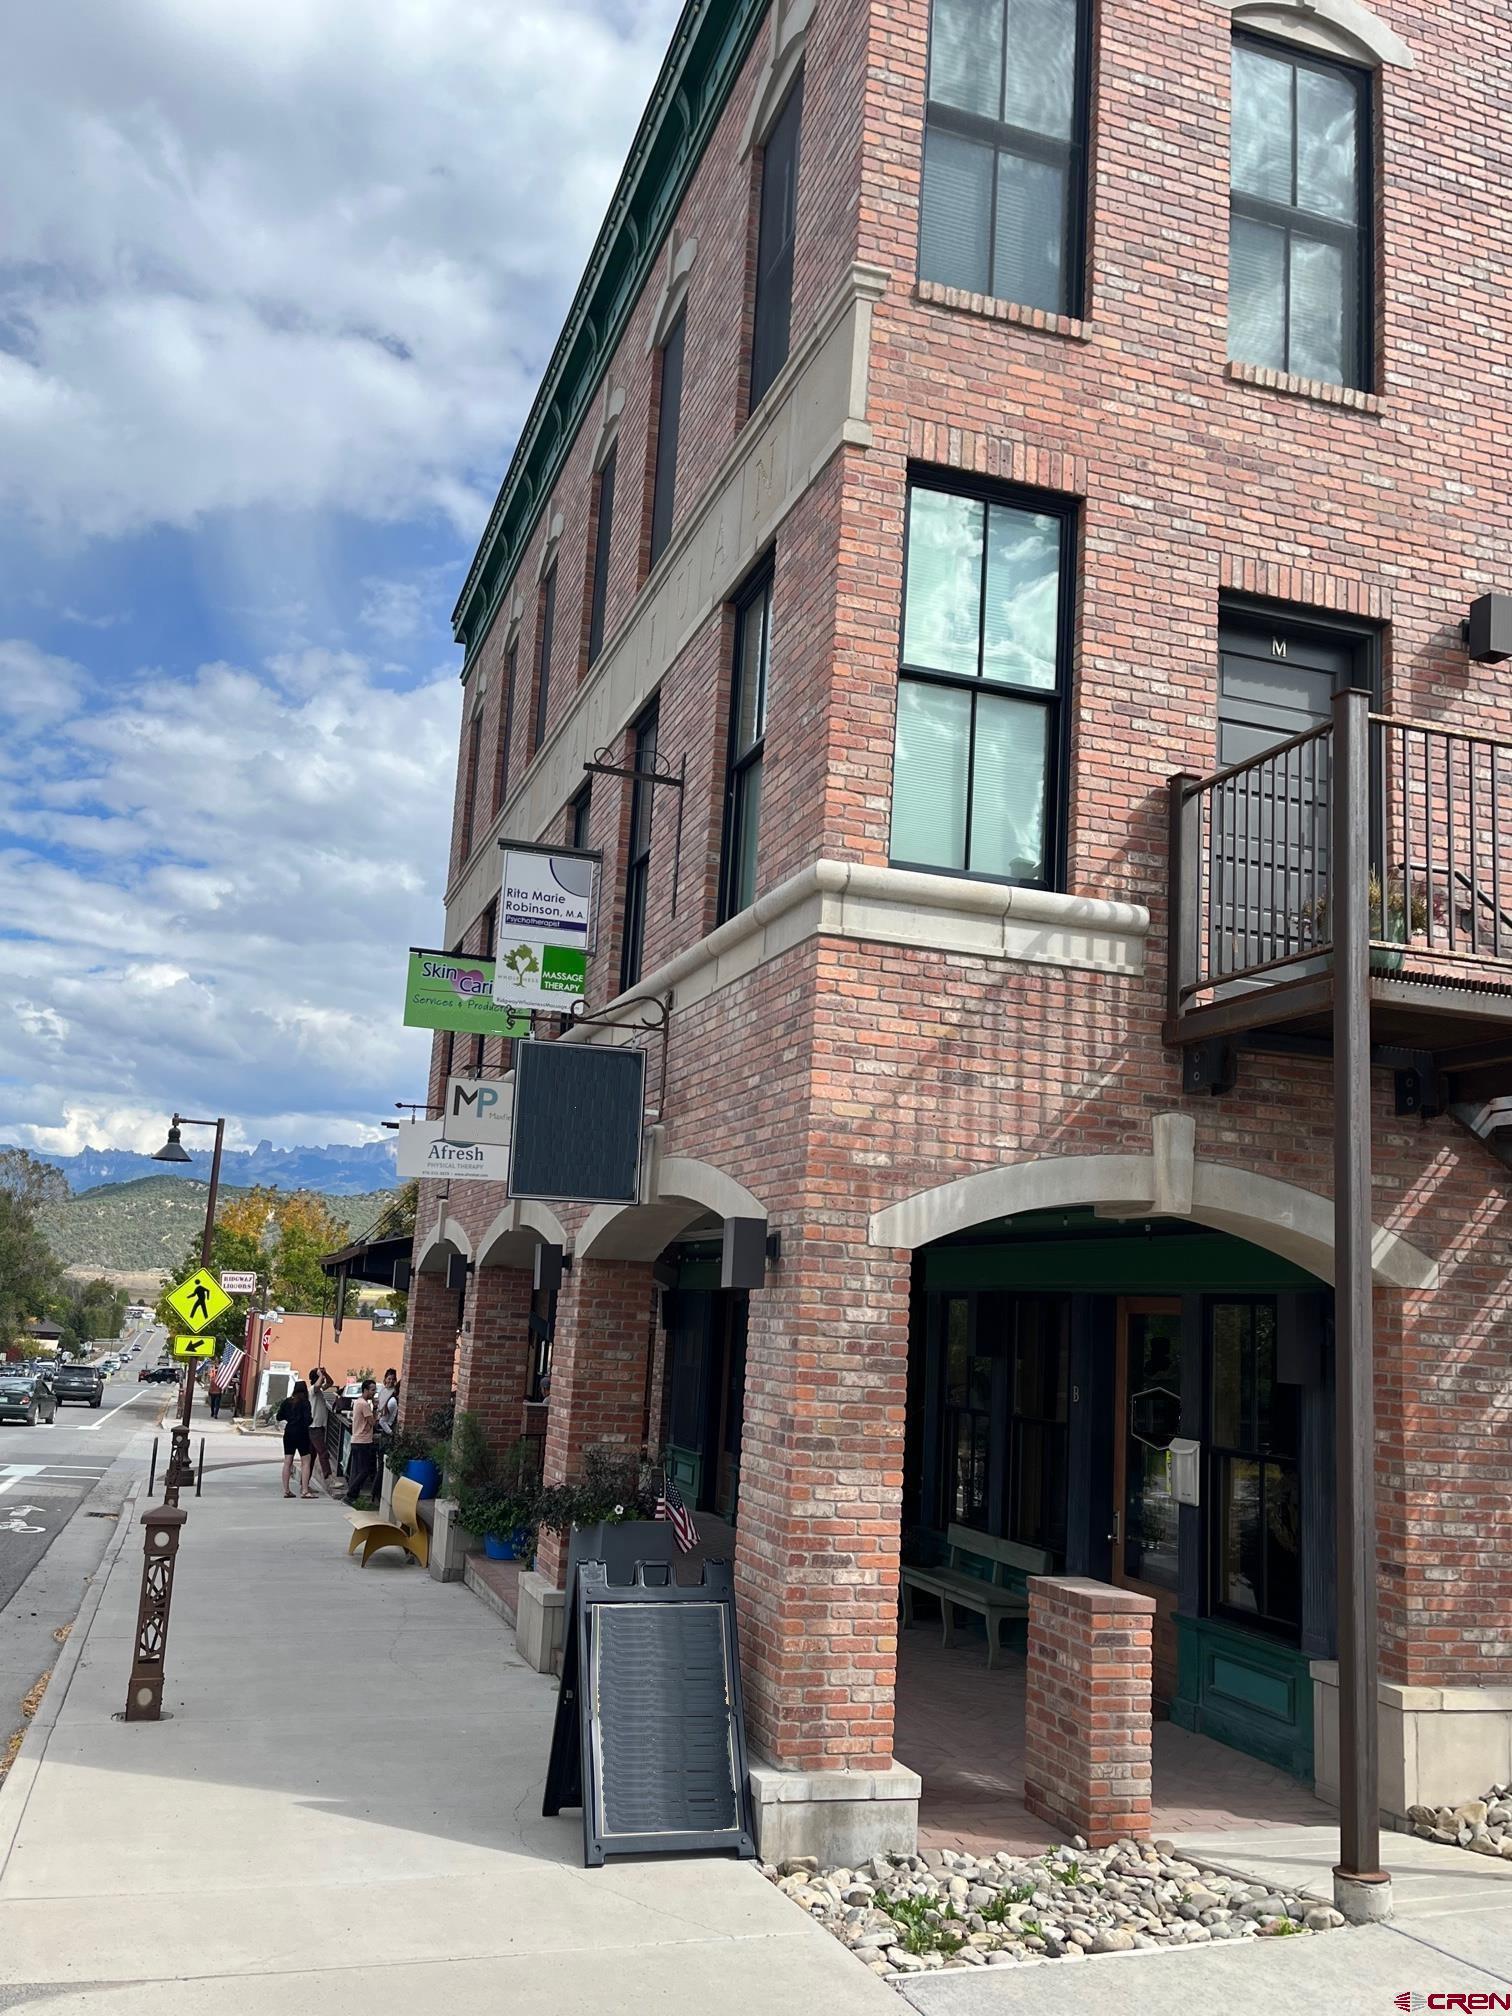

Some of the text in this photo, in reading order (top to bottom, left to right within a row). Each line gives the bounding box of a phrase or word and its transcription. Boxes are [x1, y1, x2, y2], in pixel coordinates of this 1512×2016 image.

[645, 434, 778, 667] JUAN
[1272, 636, 1287, 658] M
[507, 887, 566, 904] Rita Marie
[505, 900, 563, 917] Robinson,
[506, 915, 560, 928] Psychotherapist
[422, 961, 457, 980] Skin
[542, 971, 584, 982] MASSAGE
[460, 977, 494, 995] Cari
[544, 981, 581, 992] THERAPY
[412, 994, 453, 1008] Services
[453, 1084, 498, 1118] MP
[428, 1144, 484, 1161] Afresh
